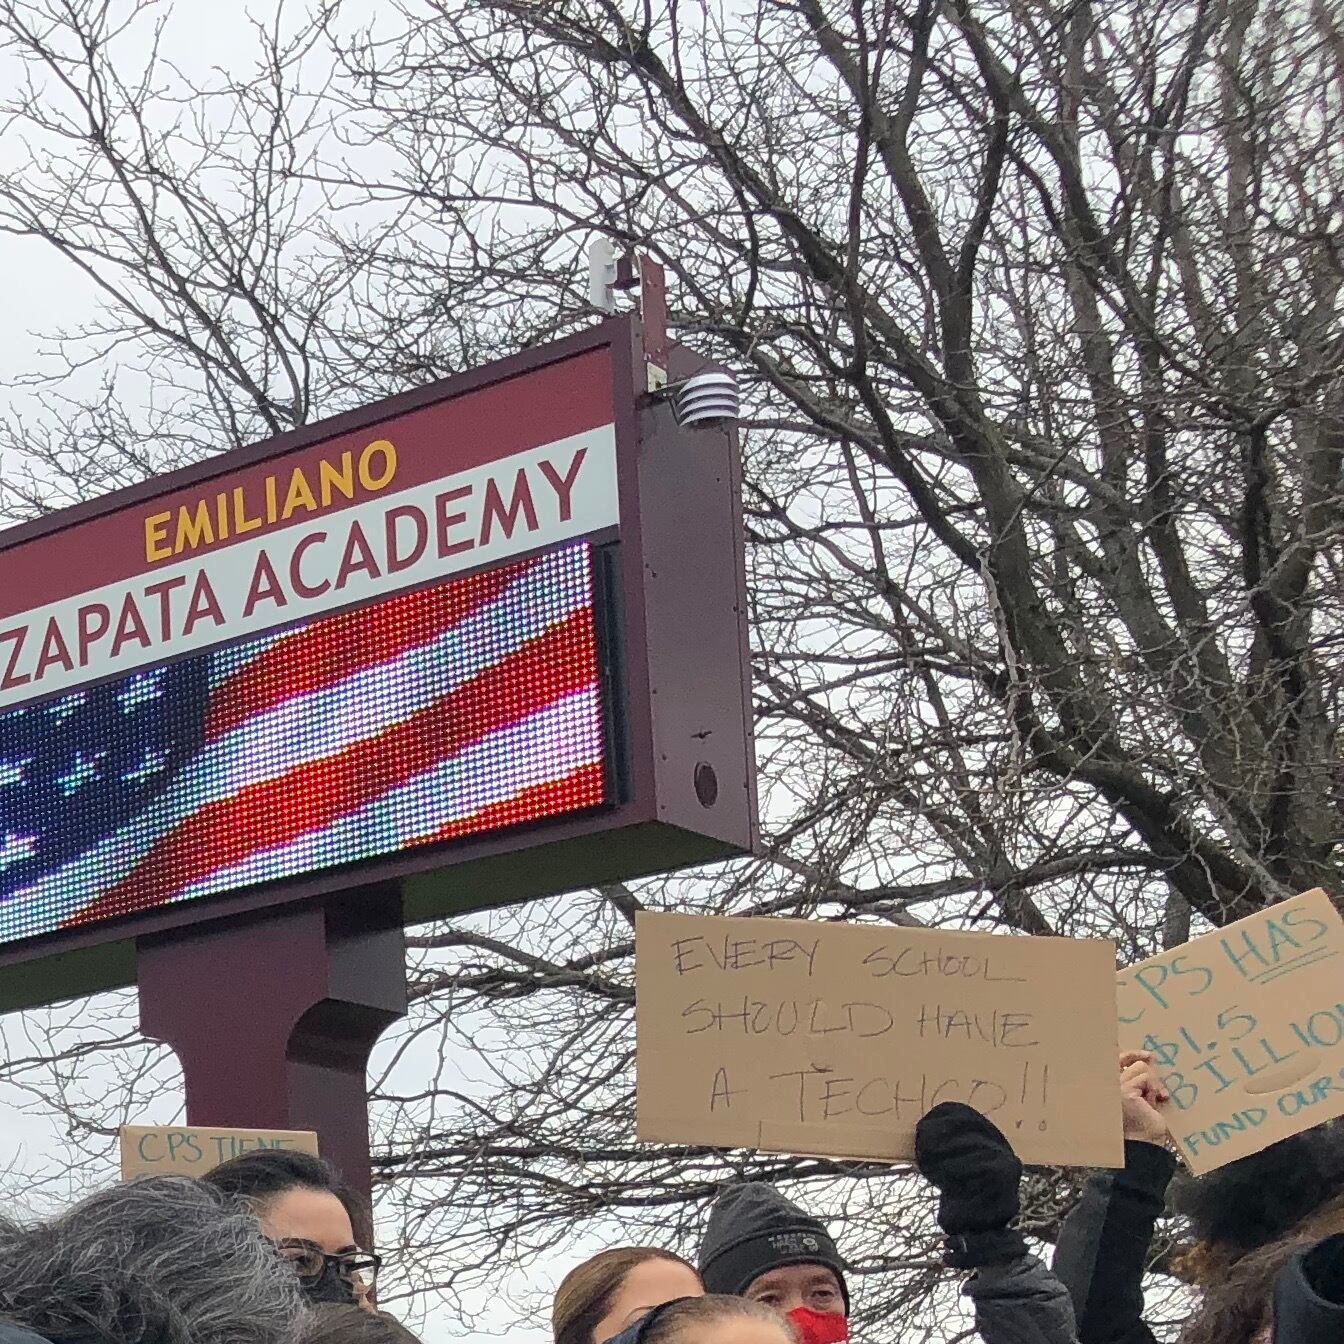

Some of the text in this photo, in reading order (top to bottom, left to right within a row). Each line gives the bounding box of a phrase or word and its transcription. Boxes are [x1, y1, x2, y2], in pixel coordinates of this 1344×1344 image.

[145, 440, 397, 563] EMILIANO
[0, 448, 588, 691] ZAPATA ACADEMY
[671, 935, 1028, 981] EVERY SCHOOL
[1220, 907, 1328, 977] HAS
[682, 996, 1039, 1047] SHOULD HAVE
[1143, 1005, 1257, 1067] $1.5
[710, 1067, 748, 1112] A
[1183, 1107, 1267, 1156] FUND
[1277, 1076, 1344, 1116] OUR
[138, 1132, 203, 1163] CPS
